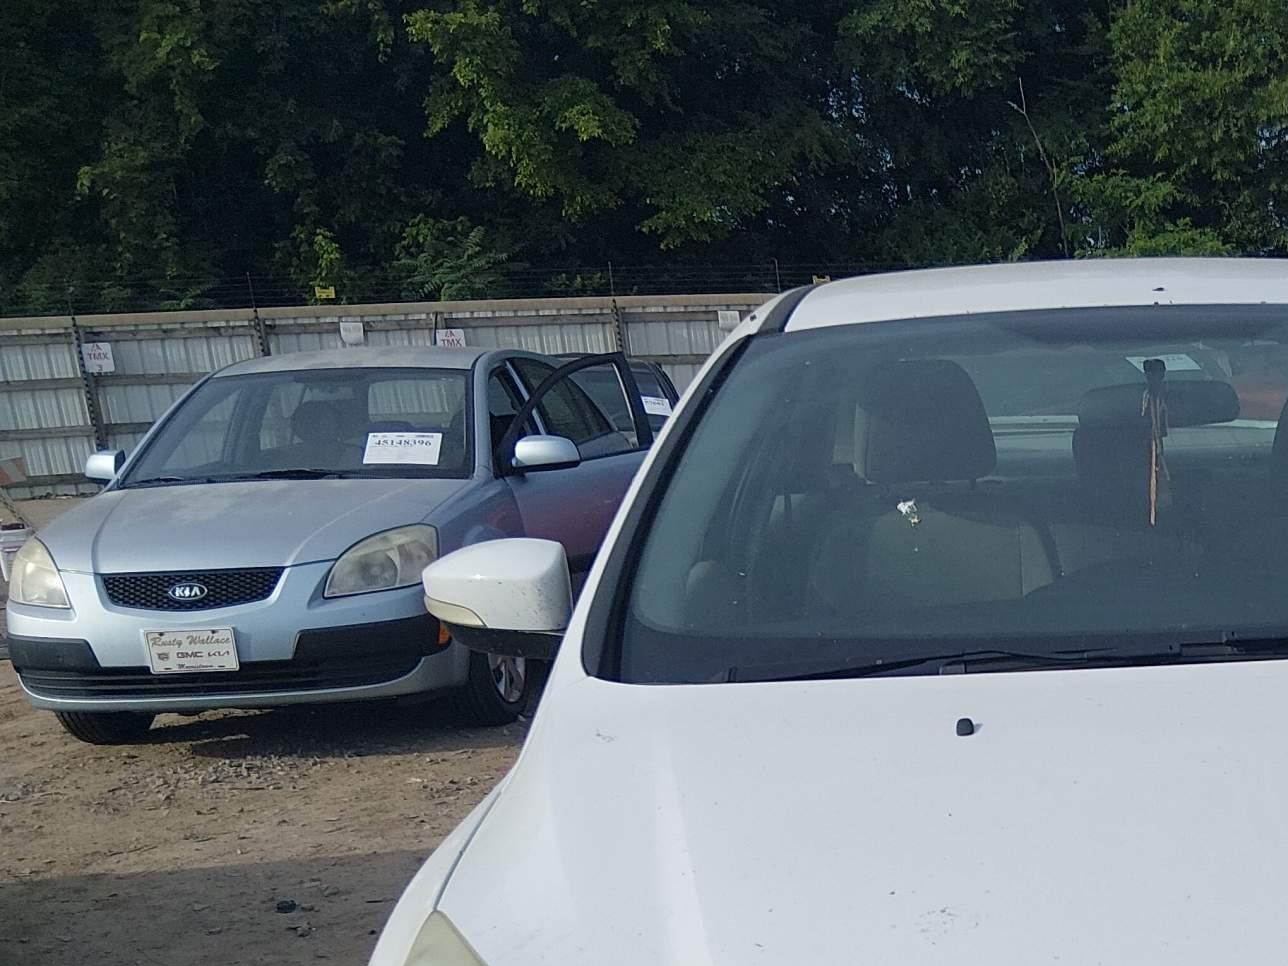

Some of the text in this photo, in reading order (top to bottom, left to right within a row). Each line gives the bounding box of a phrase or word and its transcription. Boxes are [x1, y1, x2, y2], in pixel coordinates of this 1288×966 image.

[375, 439, 432, 447] 45148396
[175, 586, 201, 597] KIA
[151, 634, 232, 649] Rusty Wallace
[176, 651, 204, 659] GMC
